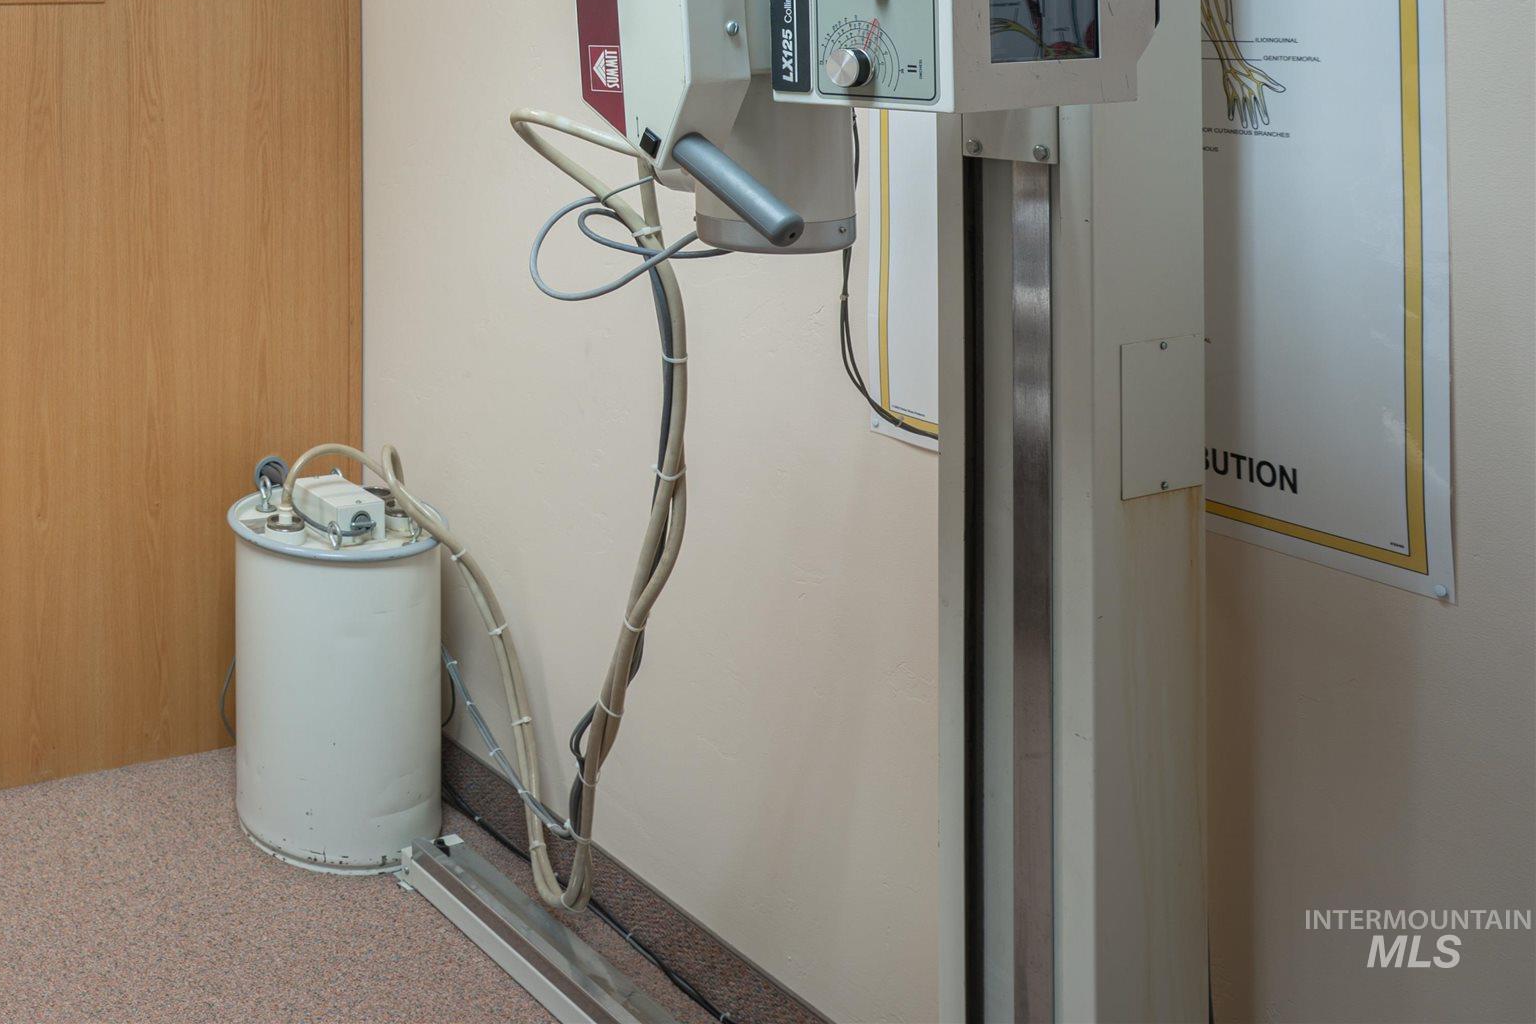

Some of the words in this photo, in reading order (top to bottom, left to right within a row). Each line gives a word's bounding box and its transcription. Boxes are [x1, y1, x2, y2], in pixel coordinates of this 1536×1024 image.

[605, 49, 620, 89] SUMMIT
[782, 29, 793, 82] LX125
[1214, 128, 1252, 136] CUTANEOUS
